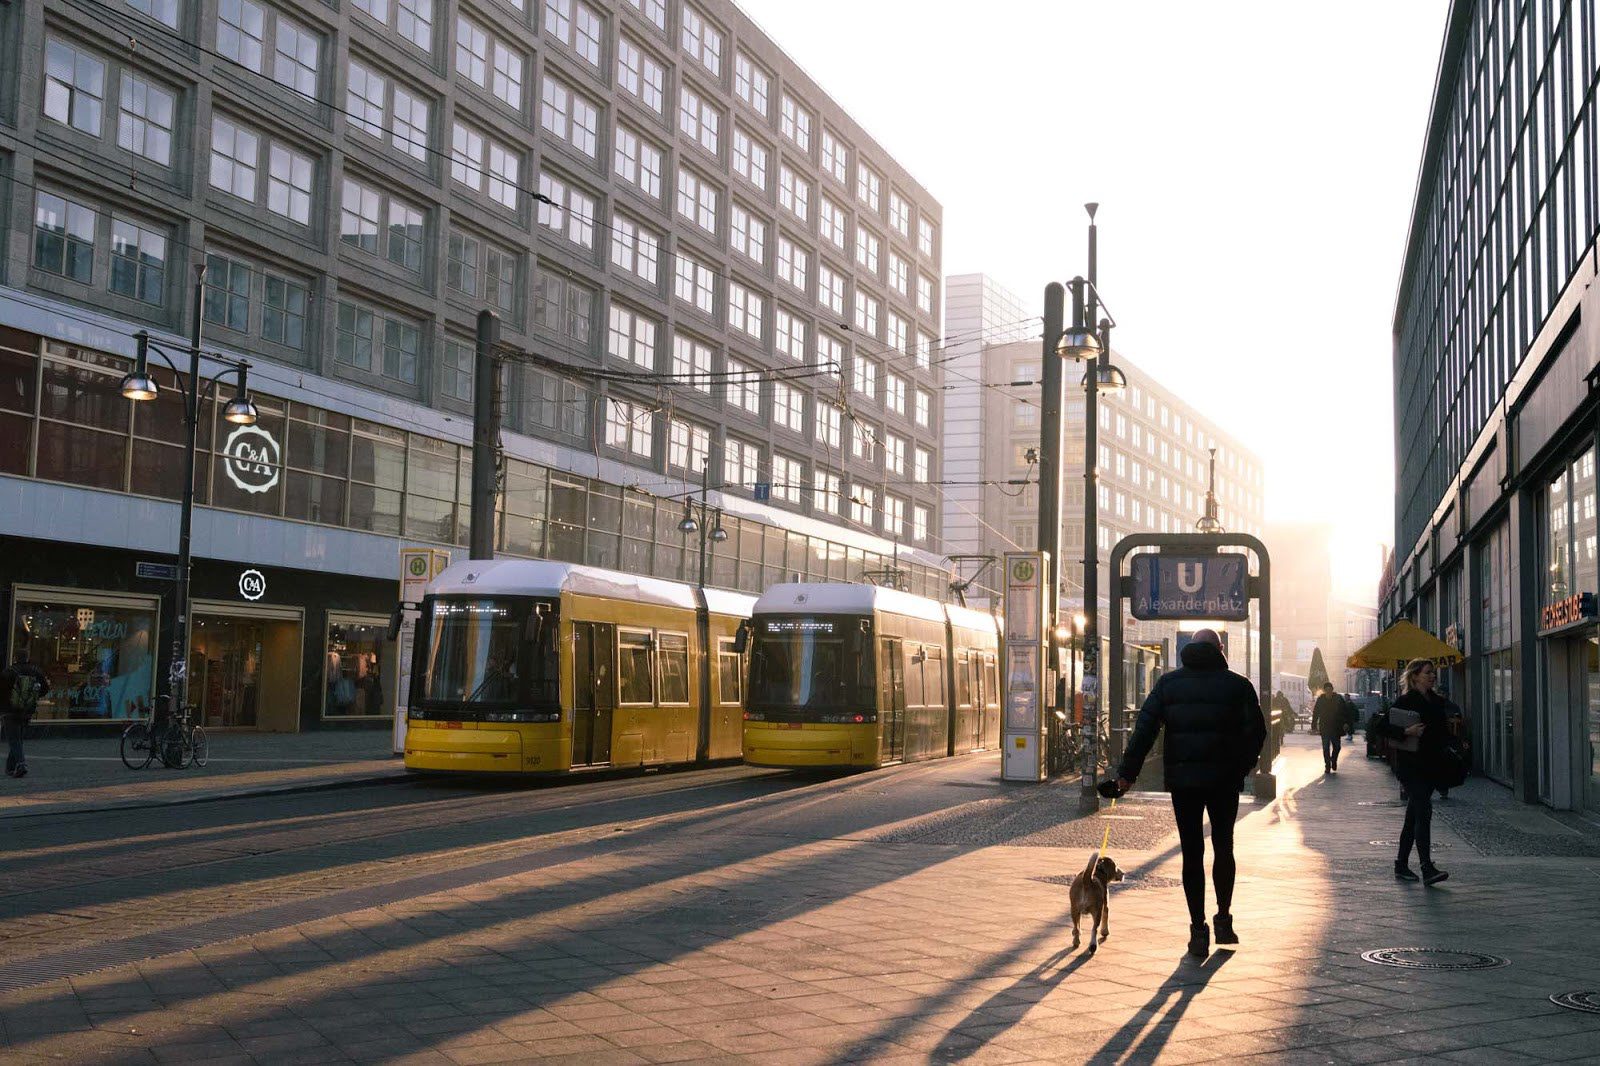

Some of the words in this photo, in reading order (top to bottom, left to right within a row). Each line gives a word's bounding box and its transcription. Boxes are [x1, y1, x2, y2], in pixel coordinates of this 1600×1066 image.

[235, 442, 272, 476] C&A
[243, 577, 261, 592] C&A
[1177, 562, 1203, 593] U
[1138, 597, 1243, 615] Alexanderplatz
